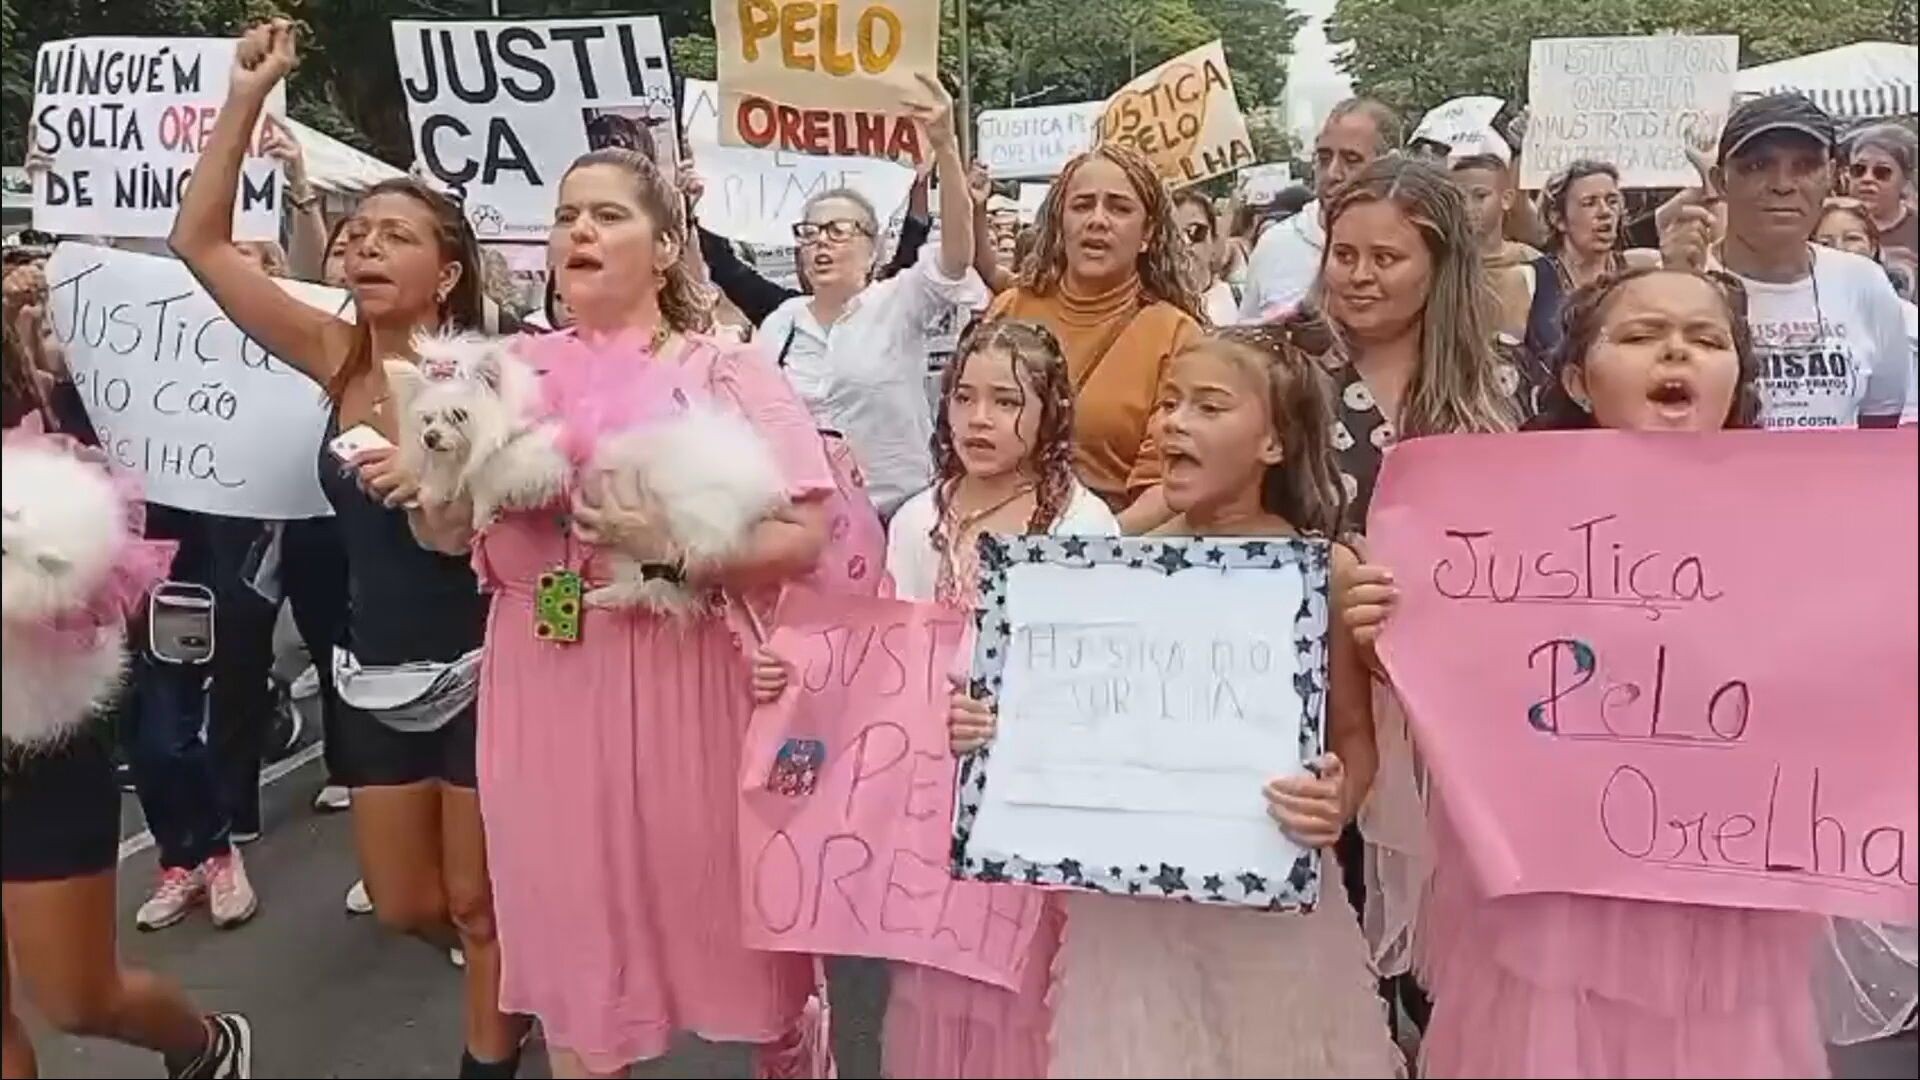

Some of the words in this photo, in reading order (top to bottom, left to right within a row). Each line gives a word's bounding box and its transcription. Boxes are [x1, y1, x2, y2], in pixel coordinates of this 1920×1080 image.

[739, 0, 901, 76] PELO
[37, 103, 144, 154] SOLTA
[159, 104, 275, 158] OREA
[420, 114, 544, 199] ÇA
[737, 96, 923, 164] ORELHA
[1117, 112, 1201, 157] PELO
[46, 169, 93, 207] DE
[1797, 415, 1838, 428] COSTA
[803, 620, 963, 703] JUST
[845, 722, 943, 821] PE
[753, 830, 1026, 962] ORELH
